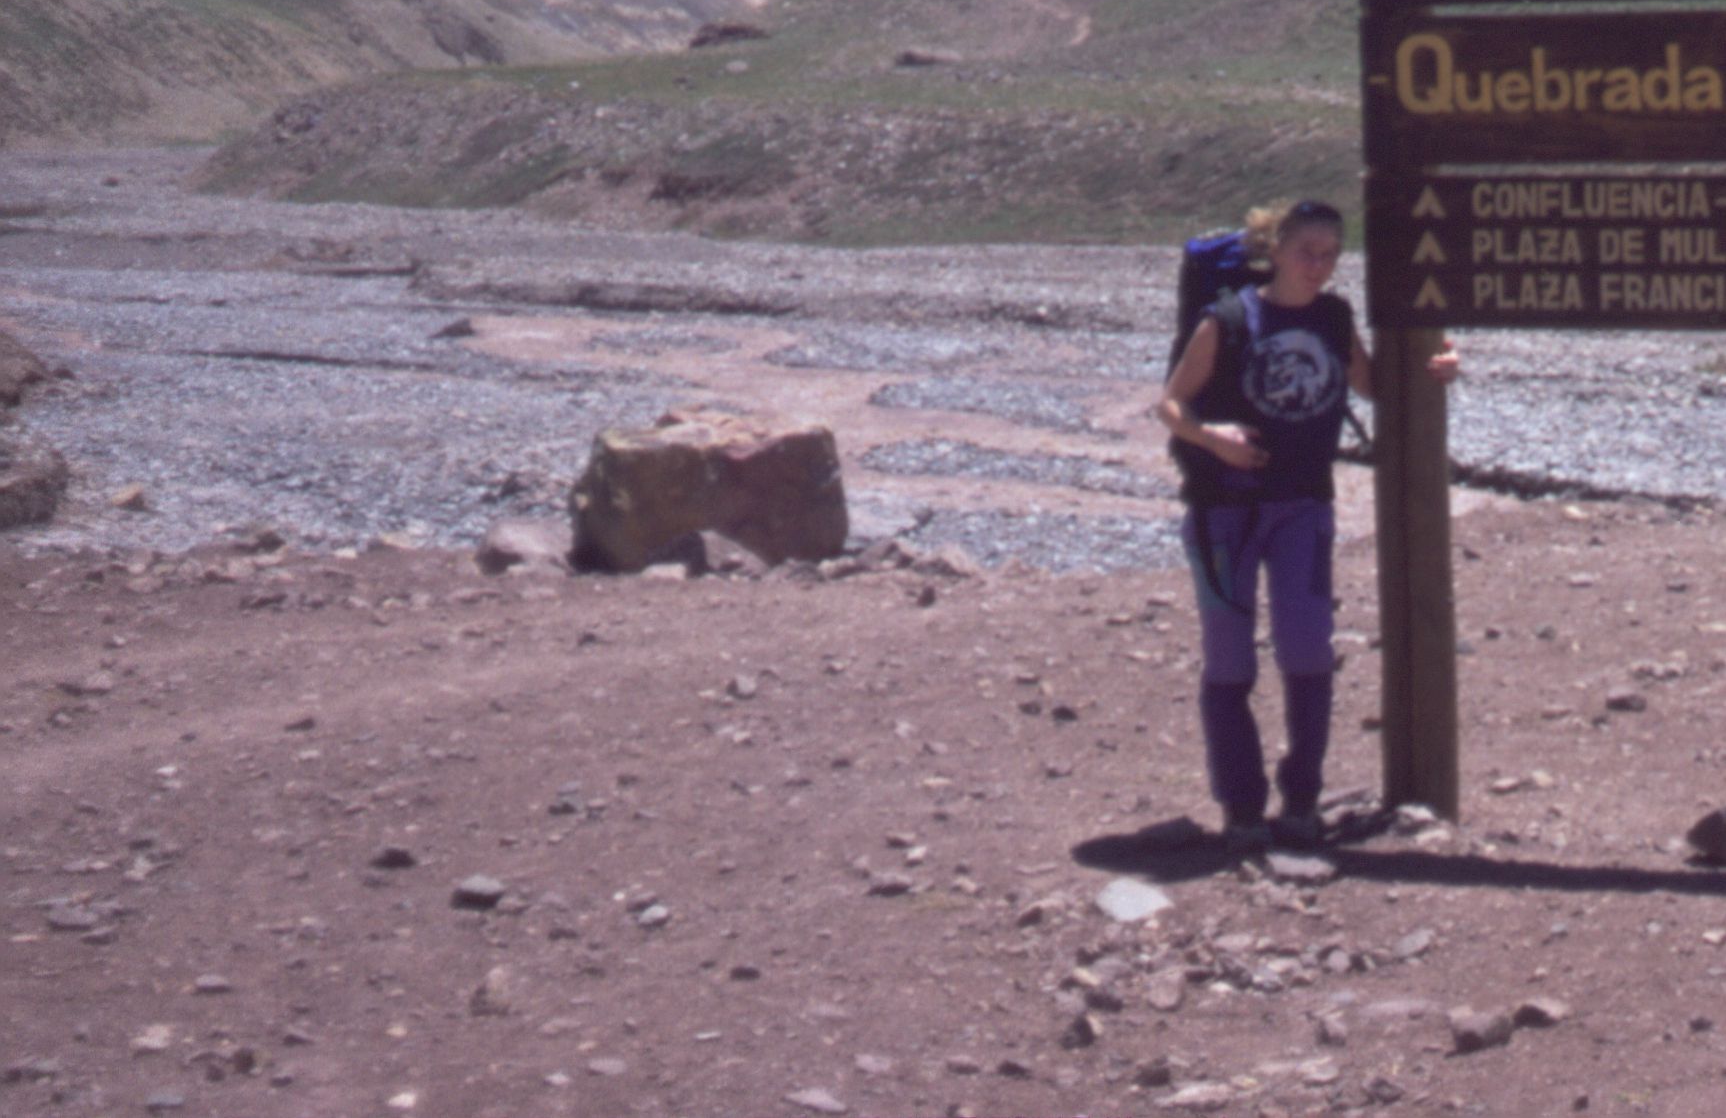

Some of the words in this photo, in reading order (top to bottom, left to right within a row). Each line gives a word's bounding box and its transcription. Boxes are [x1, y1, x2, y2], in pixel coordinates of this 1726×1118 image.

[1395, 31, 1724, 115] Quebrada
[1472, 181, 1711, 219] CONFLUENCIA
[1472, 227, 1583, 264] PLAZA
[1598, 227, 1645, 264] DE
[1473, 272, 1584, 311] PLAZA
